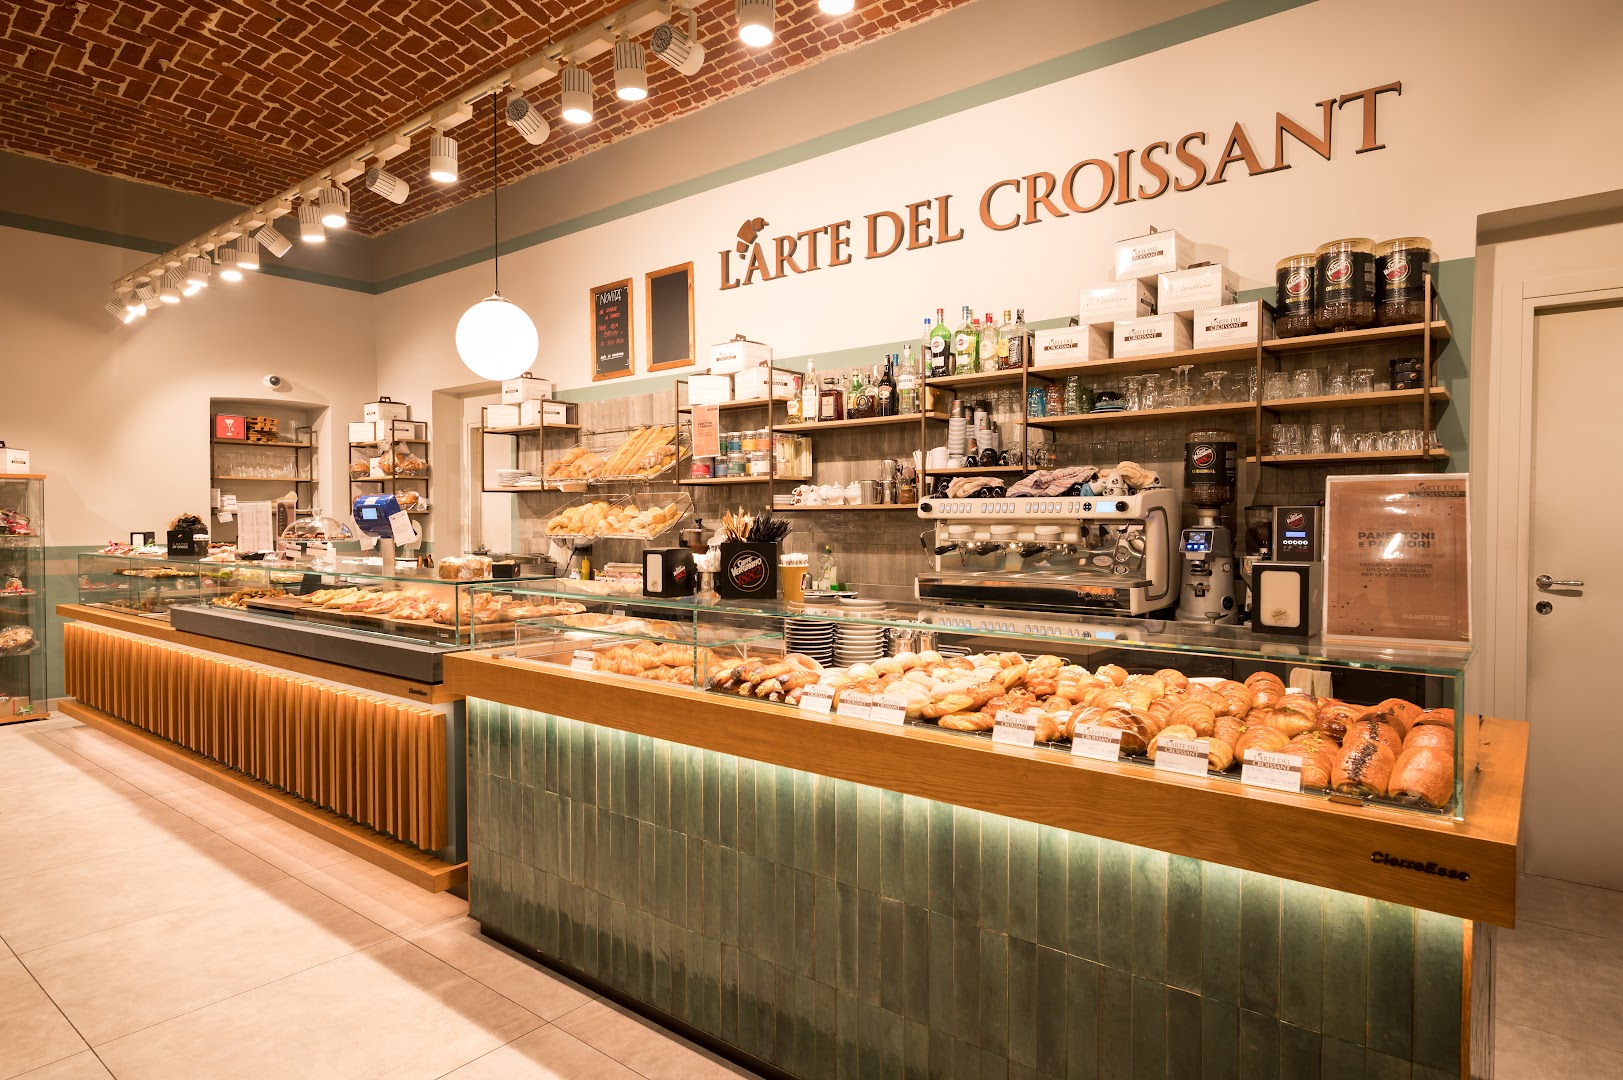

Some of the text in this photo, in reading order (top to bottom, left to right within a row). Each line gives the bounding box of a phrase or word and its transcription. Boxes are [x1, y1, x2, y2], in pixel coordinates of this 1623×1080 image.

[718, 81, 1402, 290] L'ARTE DEL CROISSANT
[1358, 532, 1435, 540] PANETONI
[1403, 613, 1450, 621] PANETTONI
[1277, 757, 1290, 765] DEL
[1253, 760, 1290, 771] CROISSANT
